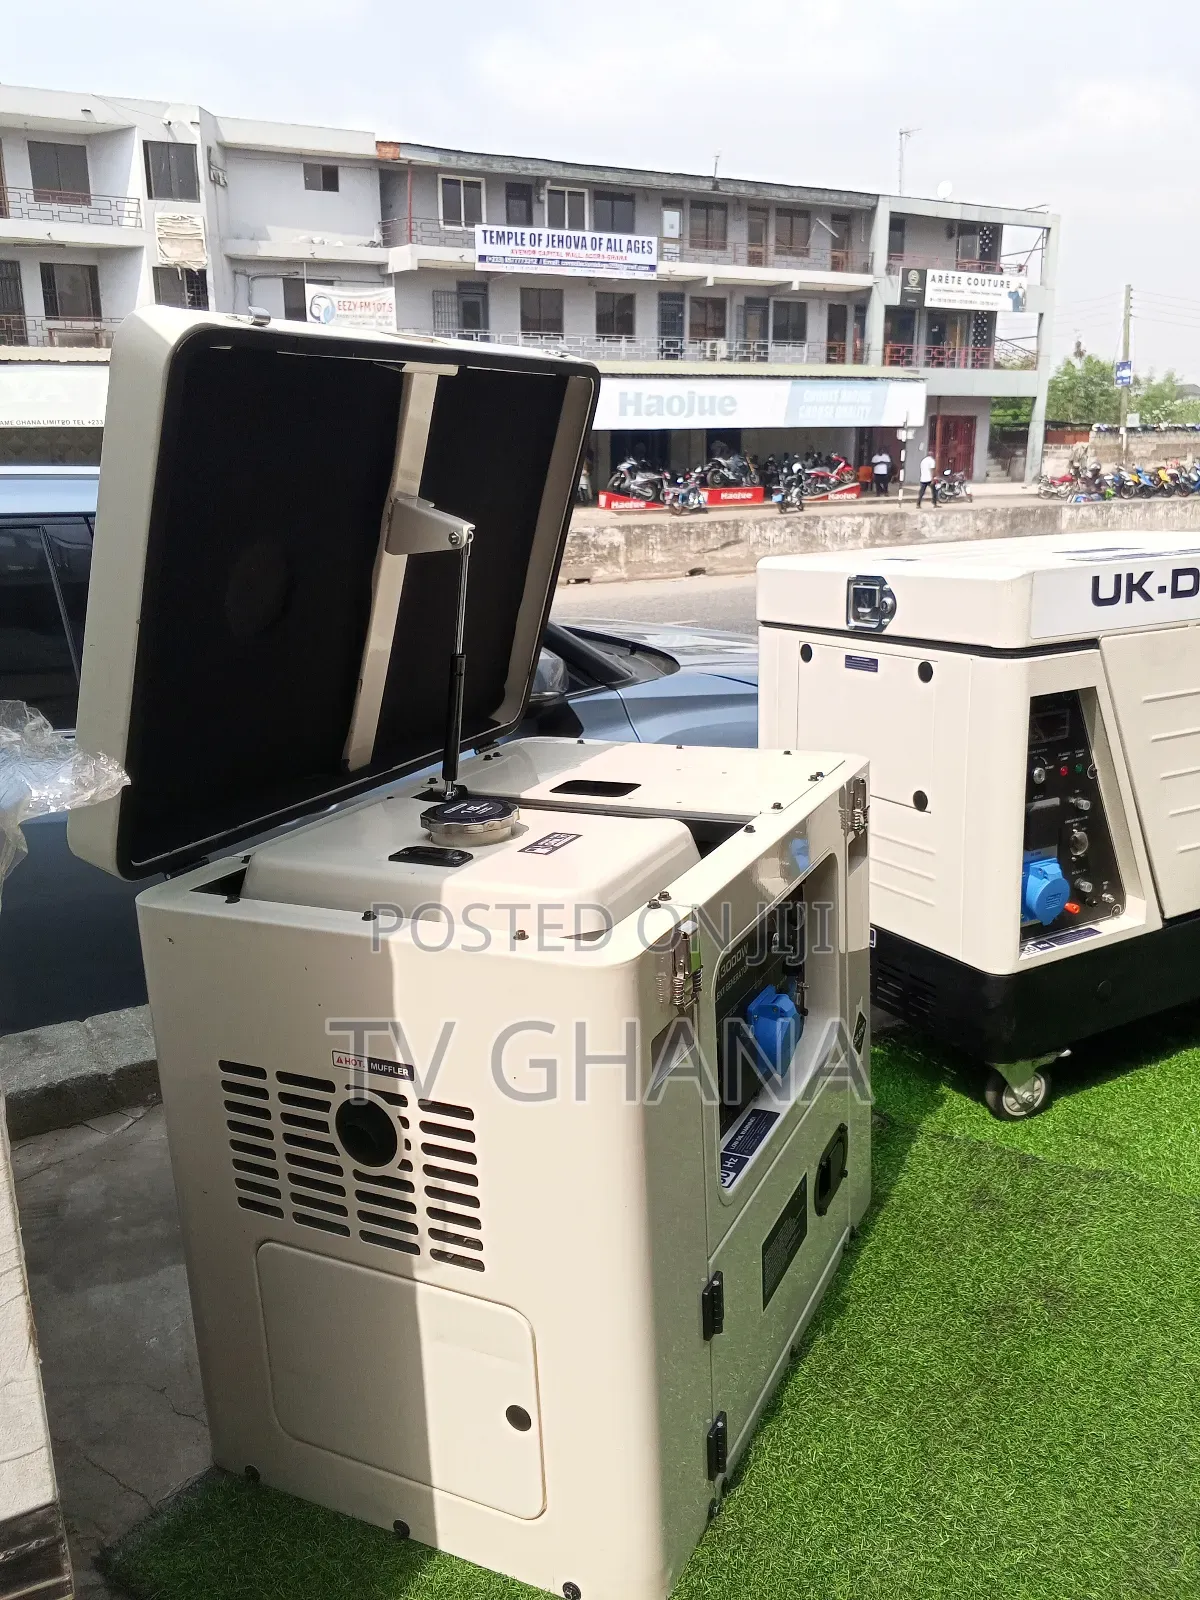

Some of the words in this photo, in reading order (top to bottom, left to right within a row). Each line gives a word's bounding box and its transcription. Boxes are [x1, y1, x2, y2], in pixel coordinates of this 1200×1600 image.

[482, 229, 526, 247] TEMPLE
[529, 232, 543, 248] OF
[545, 233, 588, 251] JEHOVA
[590, 236, 604, 252] OF
[606, 237, 624, 253] ALL
[626, 239, 653, 255] AGES
[966, 276, 1011, 289] COUTURE
[337, 300, 357, 311] EEZY
[359, 301, 372, 313] FM
[618, 390, 738, 419] Haojue
[370, 1062, 409, 1077] MUFFLER
[722, 1157, 739, 1168] Hz
